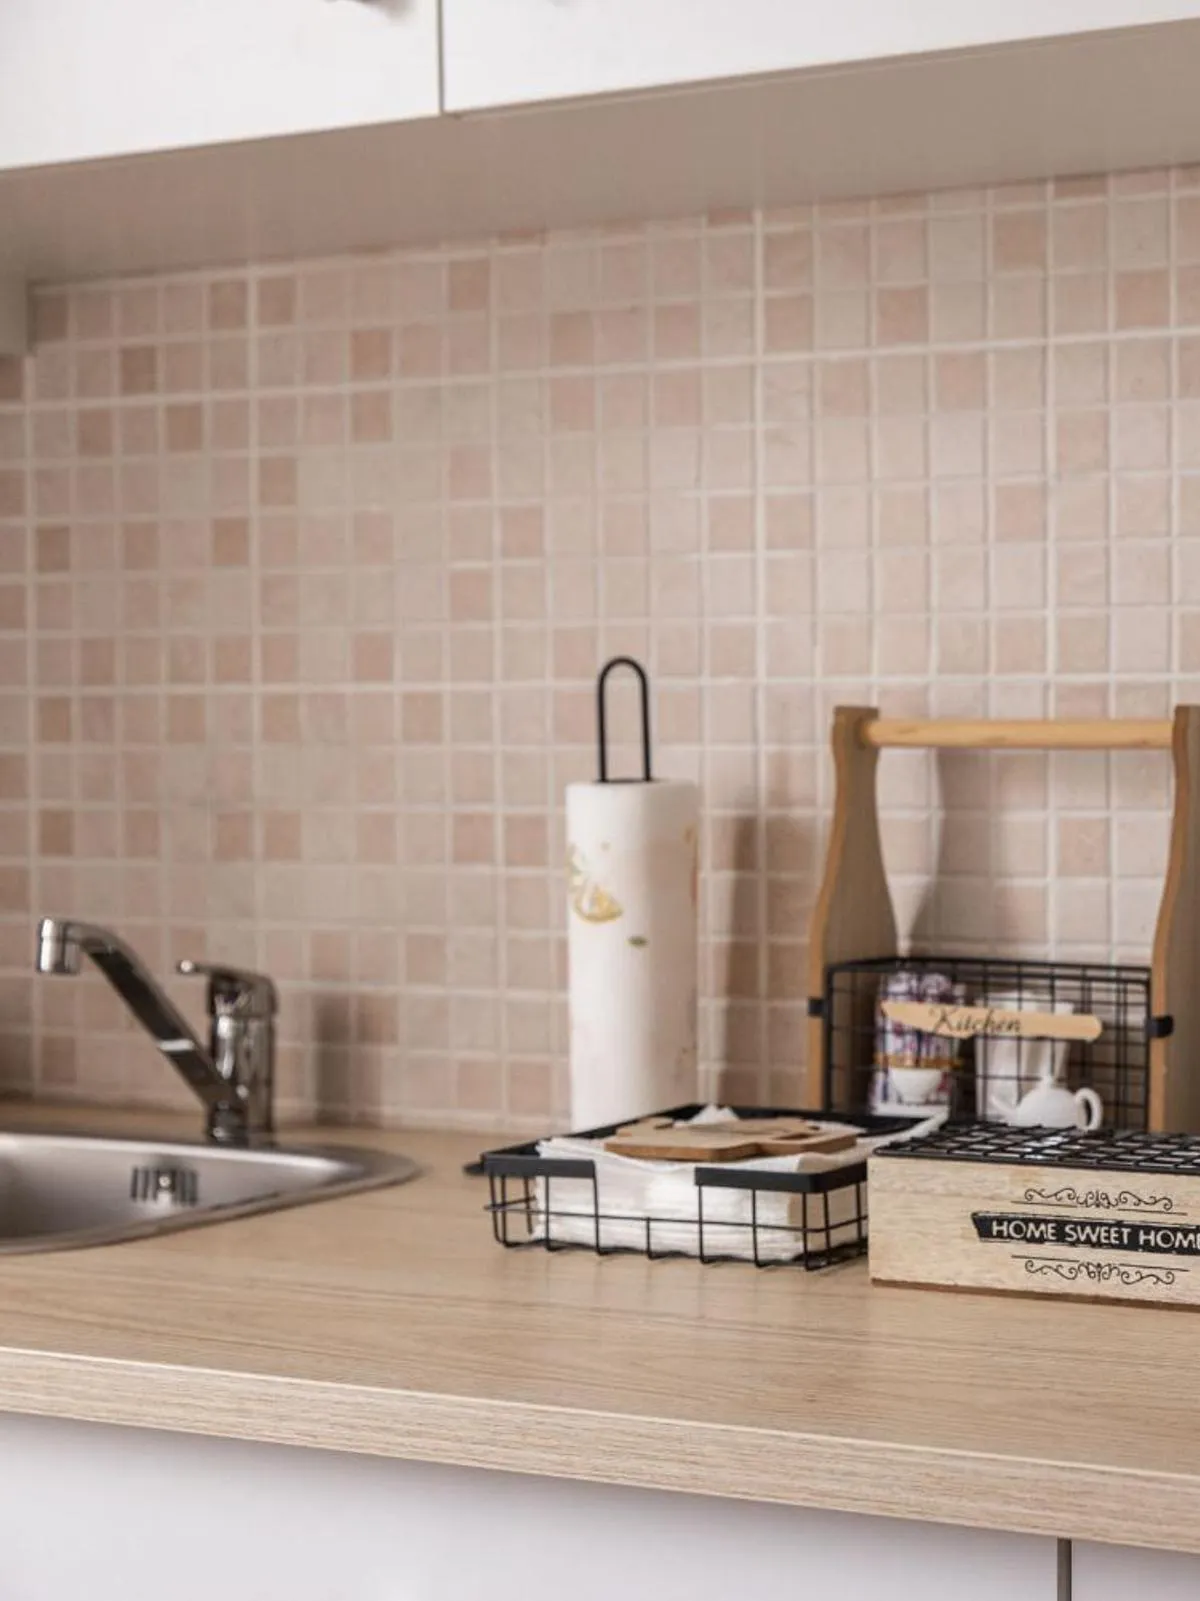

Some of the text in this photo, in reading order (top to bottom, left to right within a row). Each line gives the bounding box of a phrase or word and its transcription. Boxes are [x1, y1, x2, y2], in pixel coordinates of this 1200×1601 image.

[928, 1007, 1022, 1033] Kitchen
[992, 1219, 1057, 1240] HOME
[1064, 1223, 1132, 1246] SWEET
